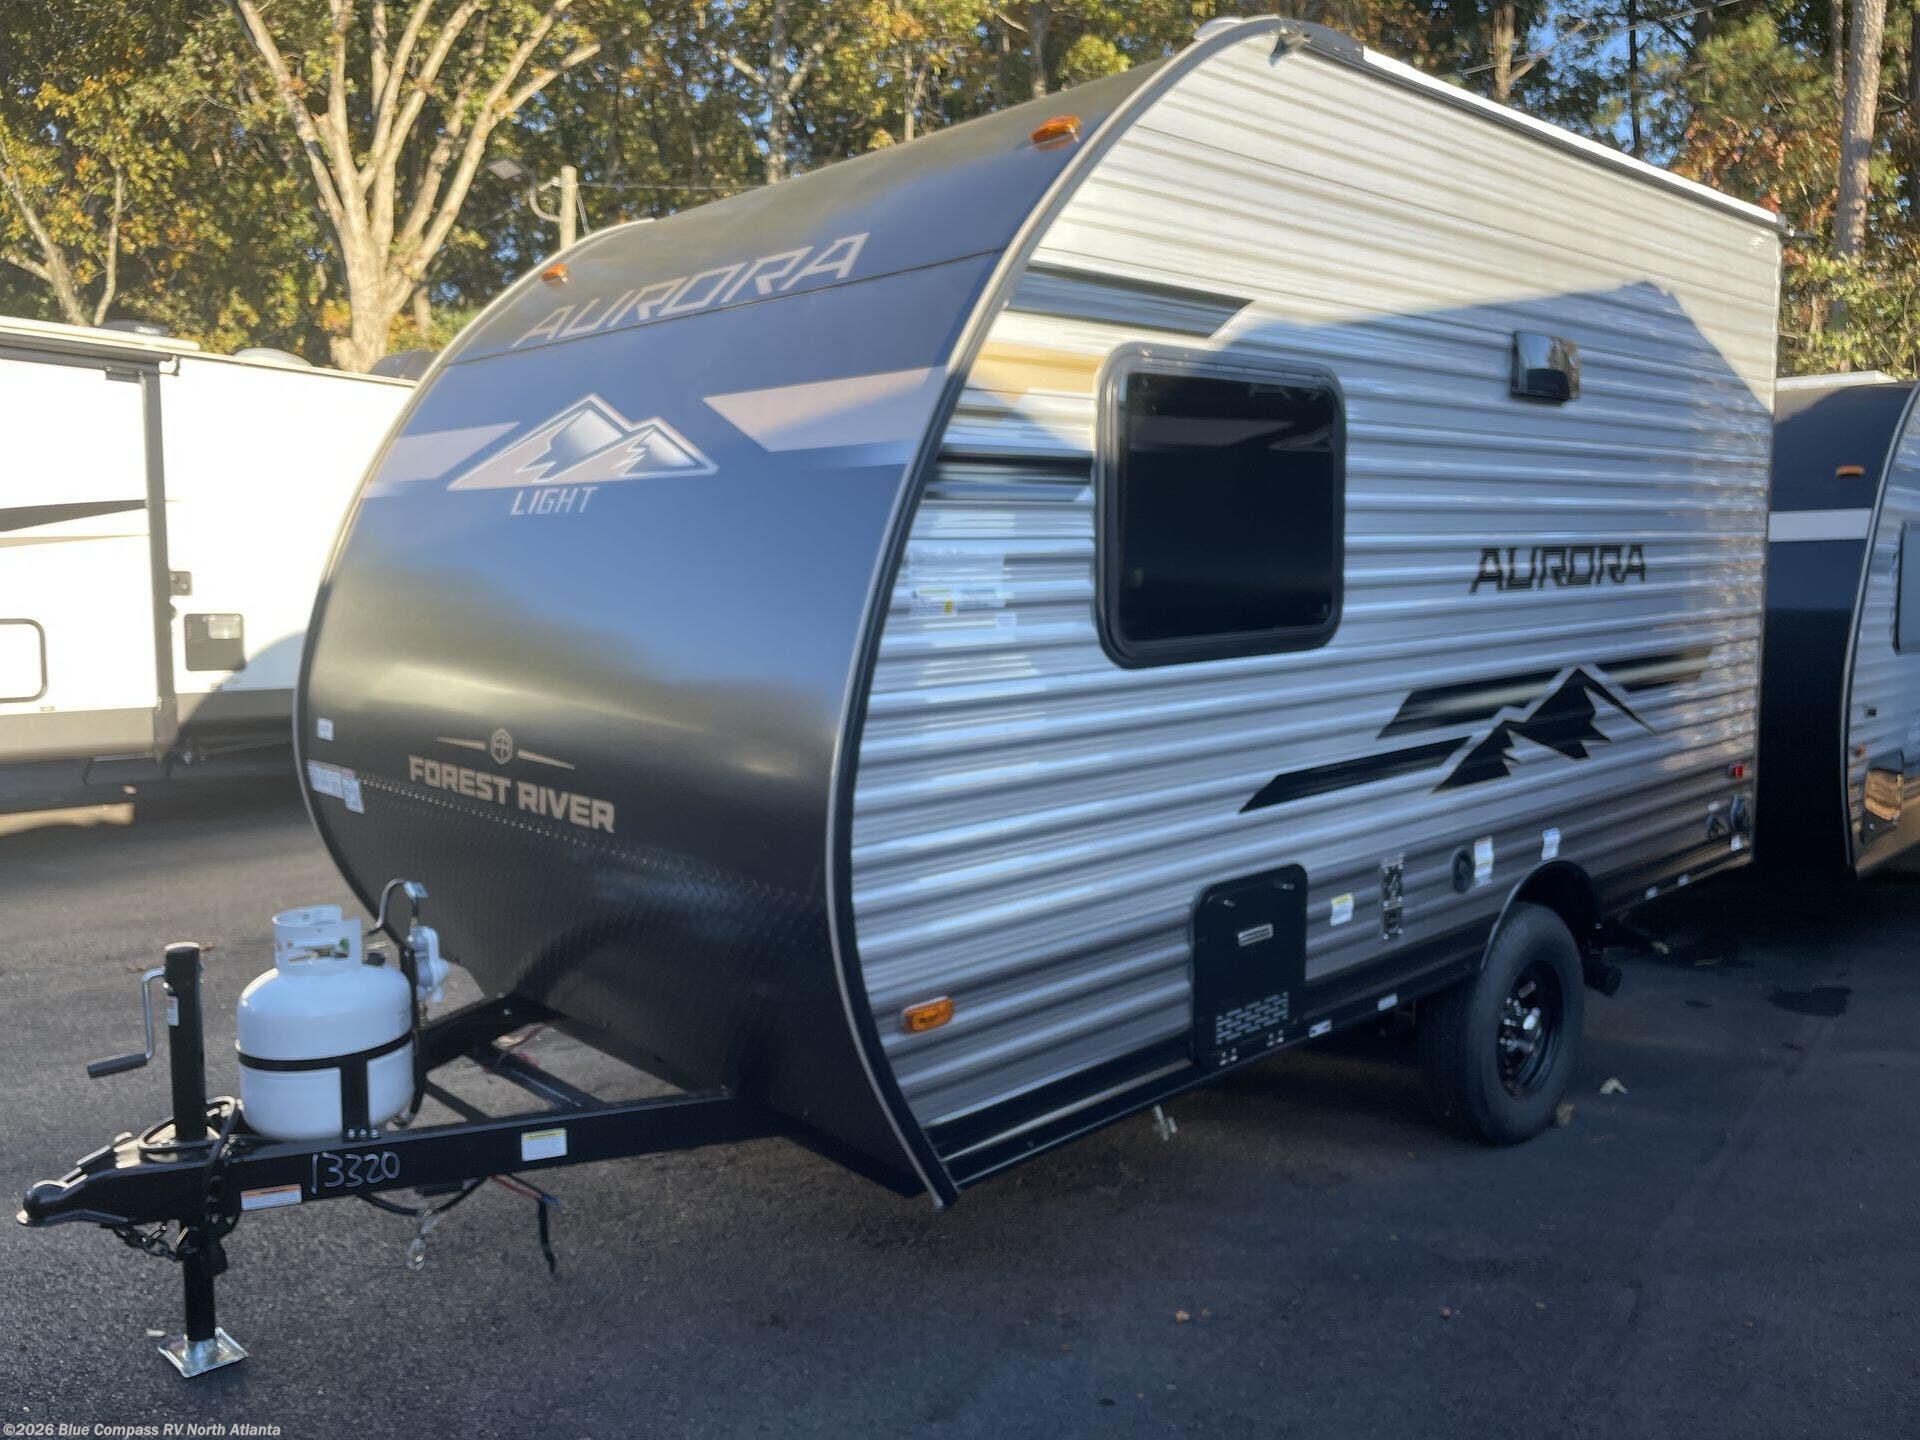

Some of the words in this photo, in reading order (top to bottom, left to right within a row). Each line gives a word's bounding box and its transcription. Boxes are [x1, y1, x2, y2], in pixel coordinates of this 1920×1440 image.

[510, 232, 871, 349] AURORA
[510, 486, 599, 516] LIGHT
[1468, 543, 1647, 595] AURORA
[408, 754, 512, 806] FOREST
[516, 780, 616, 834] RIVER
[311, 1151, 400, 1195] 13320
